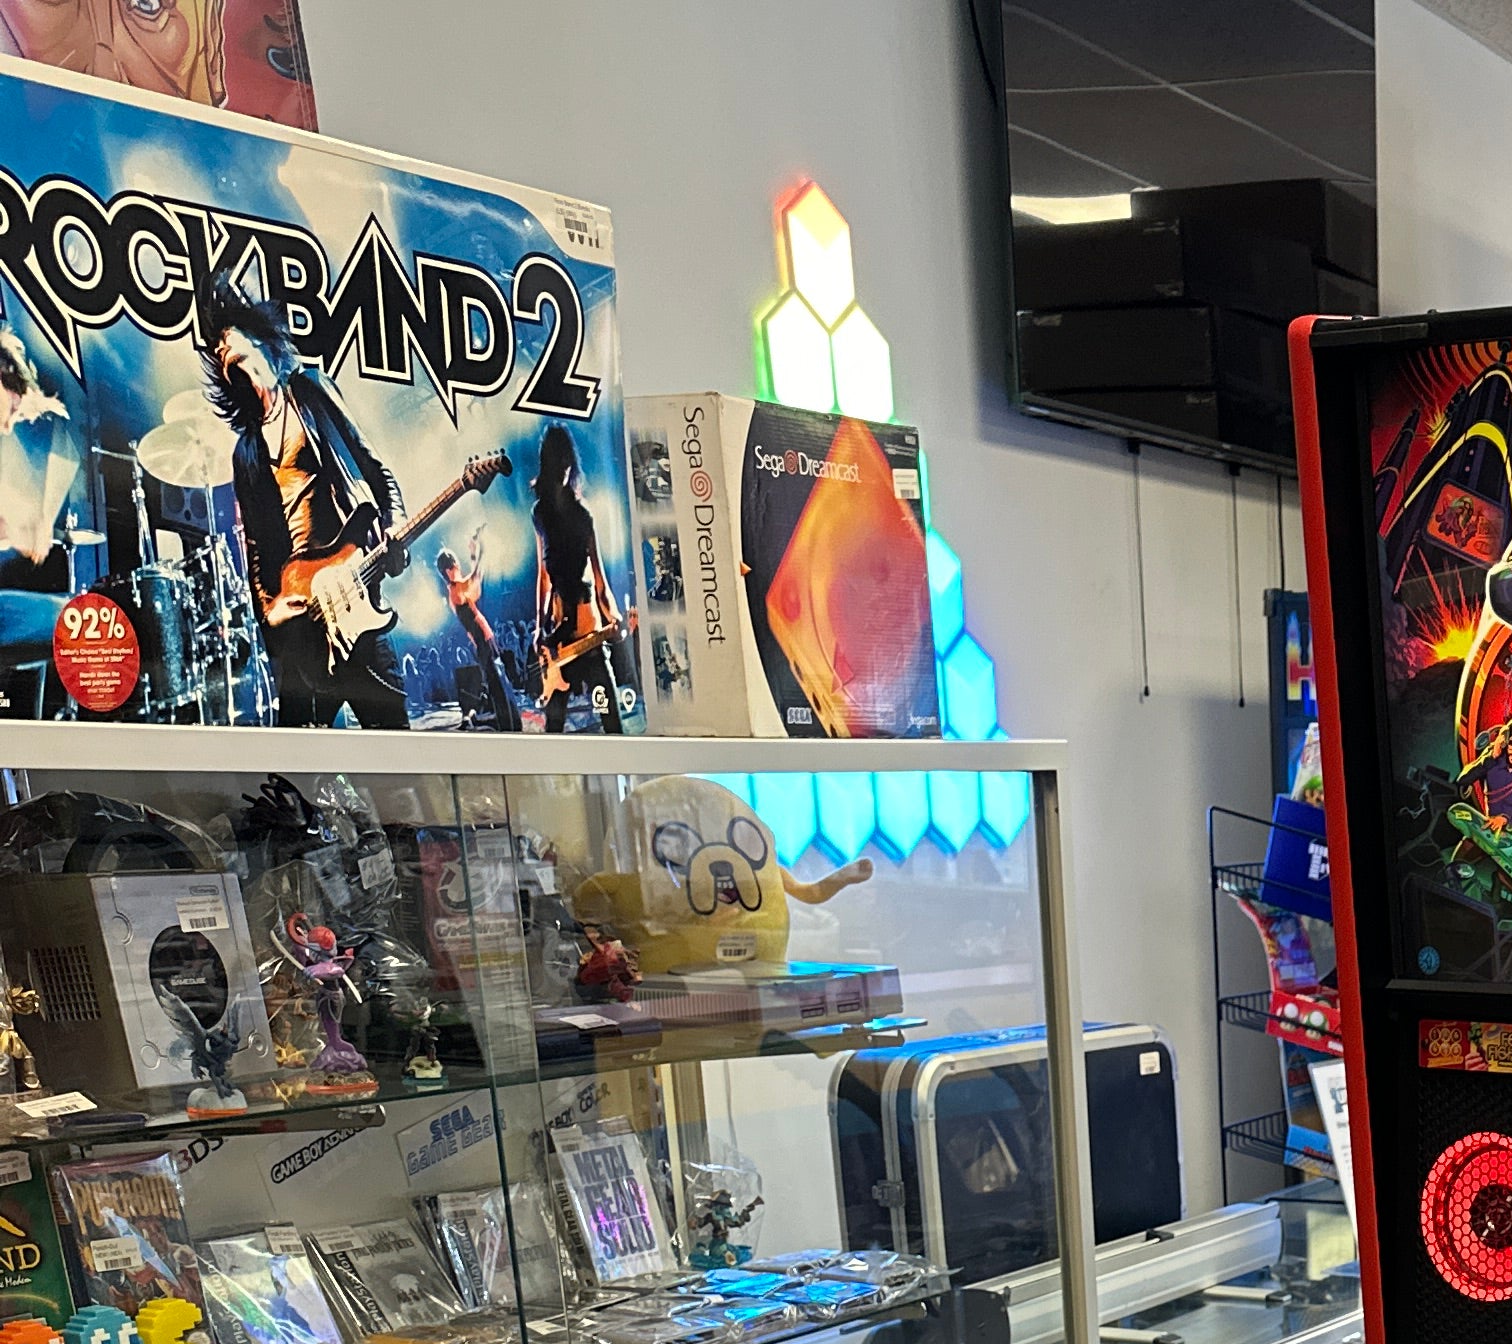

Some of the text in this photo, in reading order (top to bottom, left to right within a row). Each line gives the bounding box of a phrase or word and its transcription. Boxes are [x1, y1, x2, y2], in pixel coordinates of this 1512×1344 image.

[220, 211, 515, 428] BAND
[512, 251, 602, 422] 2
[755, 445, 785, 478] Sega
[798, 451, 862, 484] Dreamcast
[682, 406, 726, 646] Sega Dreamcast
[63, 607, 126, 640] 92%
[787, 707, 812, 724] SEGA
[429, 1105, 473, 1144] SEGA
[271, 1137, 326, 1184] GAME BOY
[572, 1145, 634, 1186] METAL
